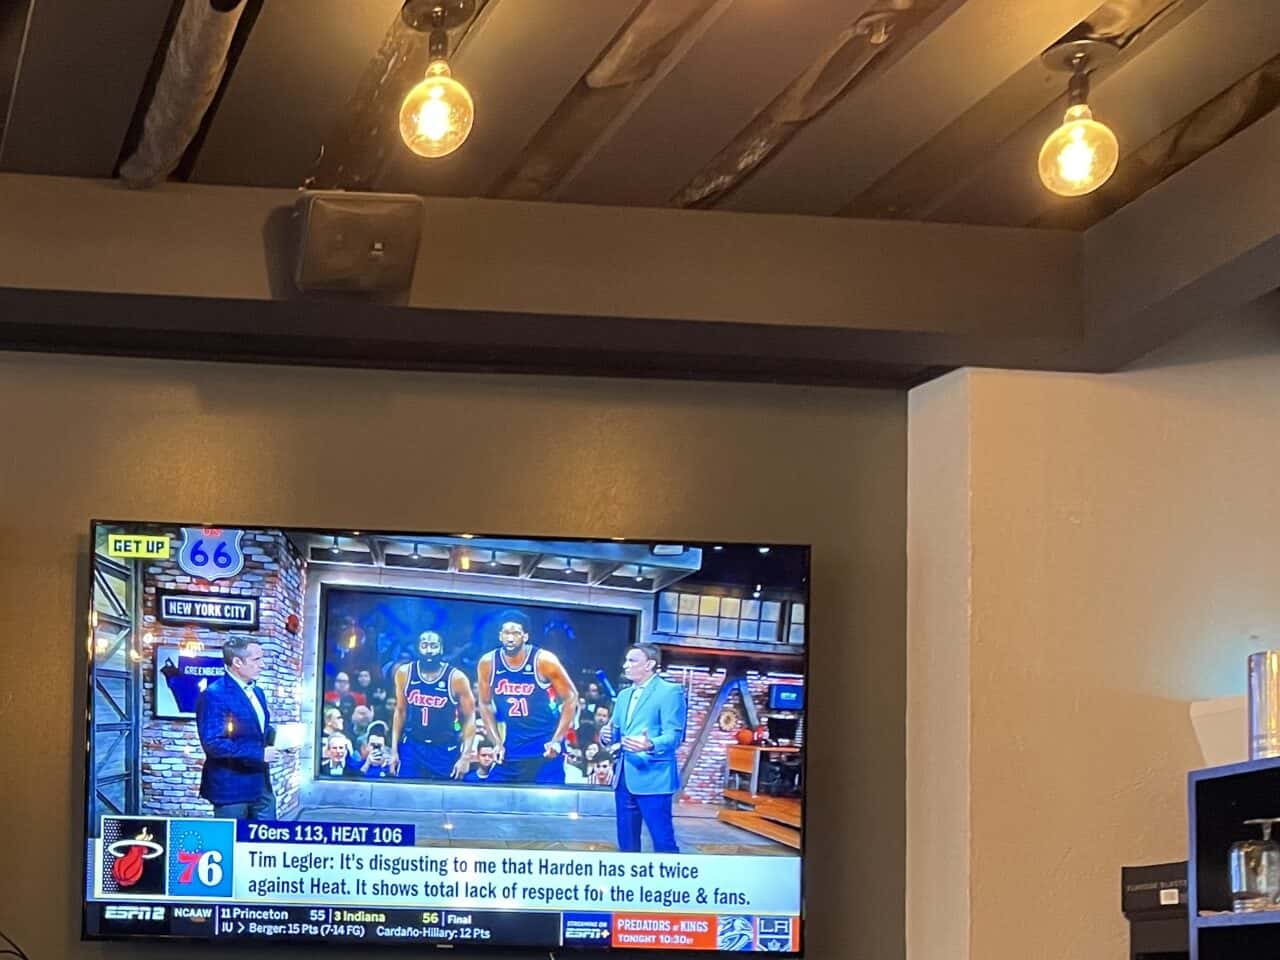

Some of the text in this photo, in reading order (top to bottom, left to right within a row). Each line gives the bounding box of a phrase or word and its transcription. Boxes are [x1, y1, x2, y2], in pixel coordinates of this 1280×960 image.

[114, 539, 164, 554] GET UP
[190, 539, 232, 568] 66
[170, 601, 246, 618] NEW YORK CITY
[508, 698, 528, 717] 21
[422, 708, 428, 727] 1
[248, 824, 402, 843] 76ers 113, HEAT 106
[249, 851, 699, 879] Tim Legler: It's disgusting to me that Harden has sat twice
[248, 877, 751, 907] against Heat. It shows total lack of respect for the league & fans.
[104, 905, 165, 920] ESPN2
[174, 907, 212, 918] NCAAW
[233, 908, 289, 920] Princeton
[310, 909, 326, 921] 55
[344, 911, 386, 922] Indiana
[422, 912, 439, 924] 56
[447, 914, 472, 925] Final
[222, 921, 233, 932] IU
[302, 924, 319, 935] Pts
[347, 925, 366, 937] FG)
[473, 929, 491, 939] Pts
[617, 919, 671, 932] PREDATORS
[680, 921, 709, 933] KINGS
[617, 934, 656, 944] TONIGHT
